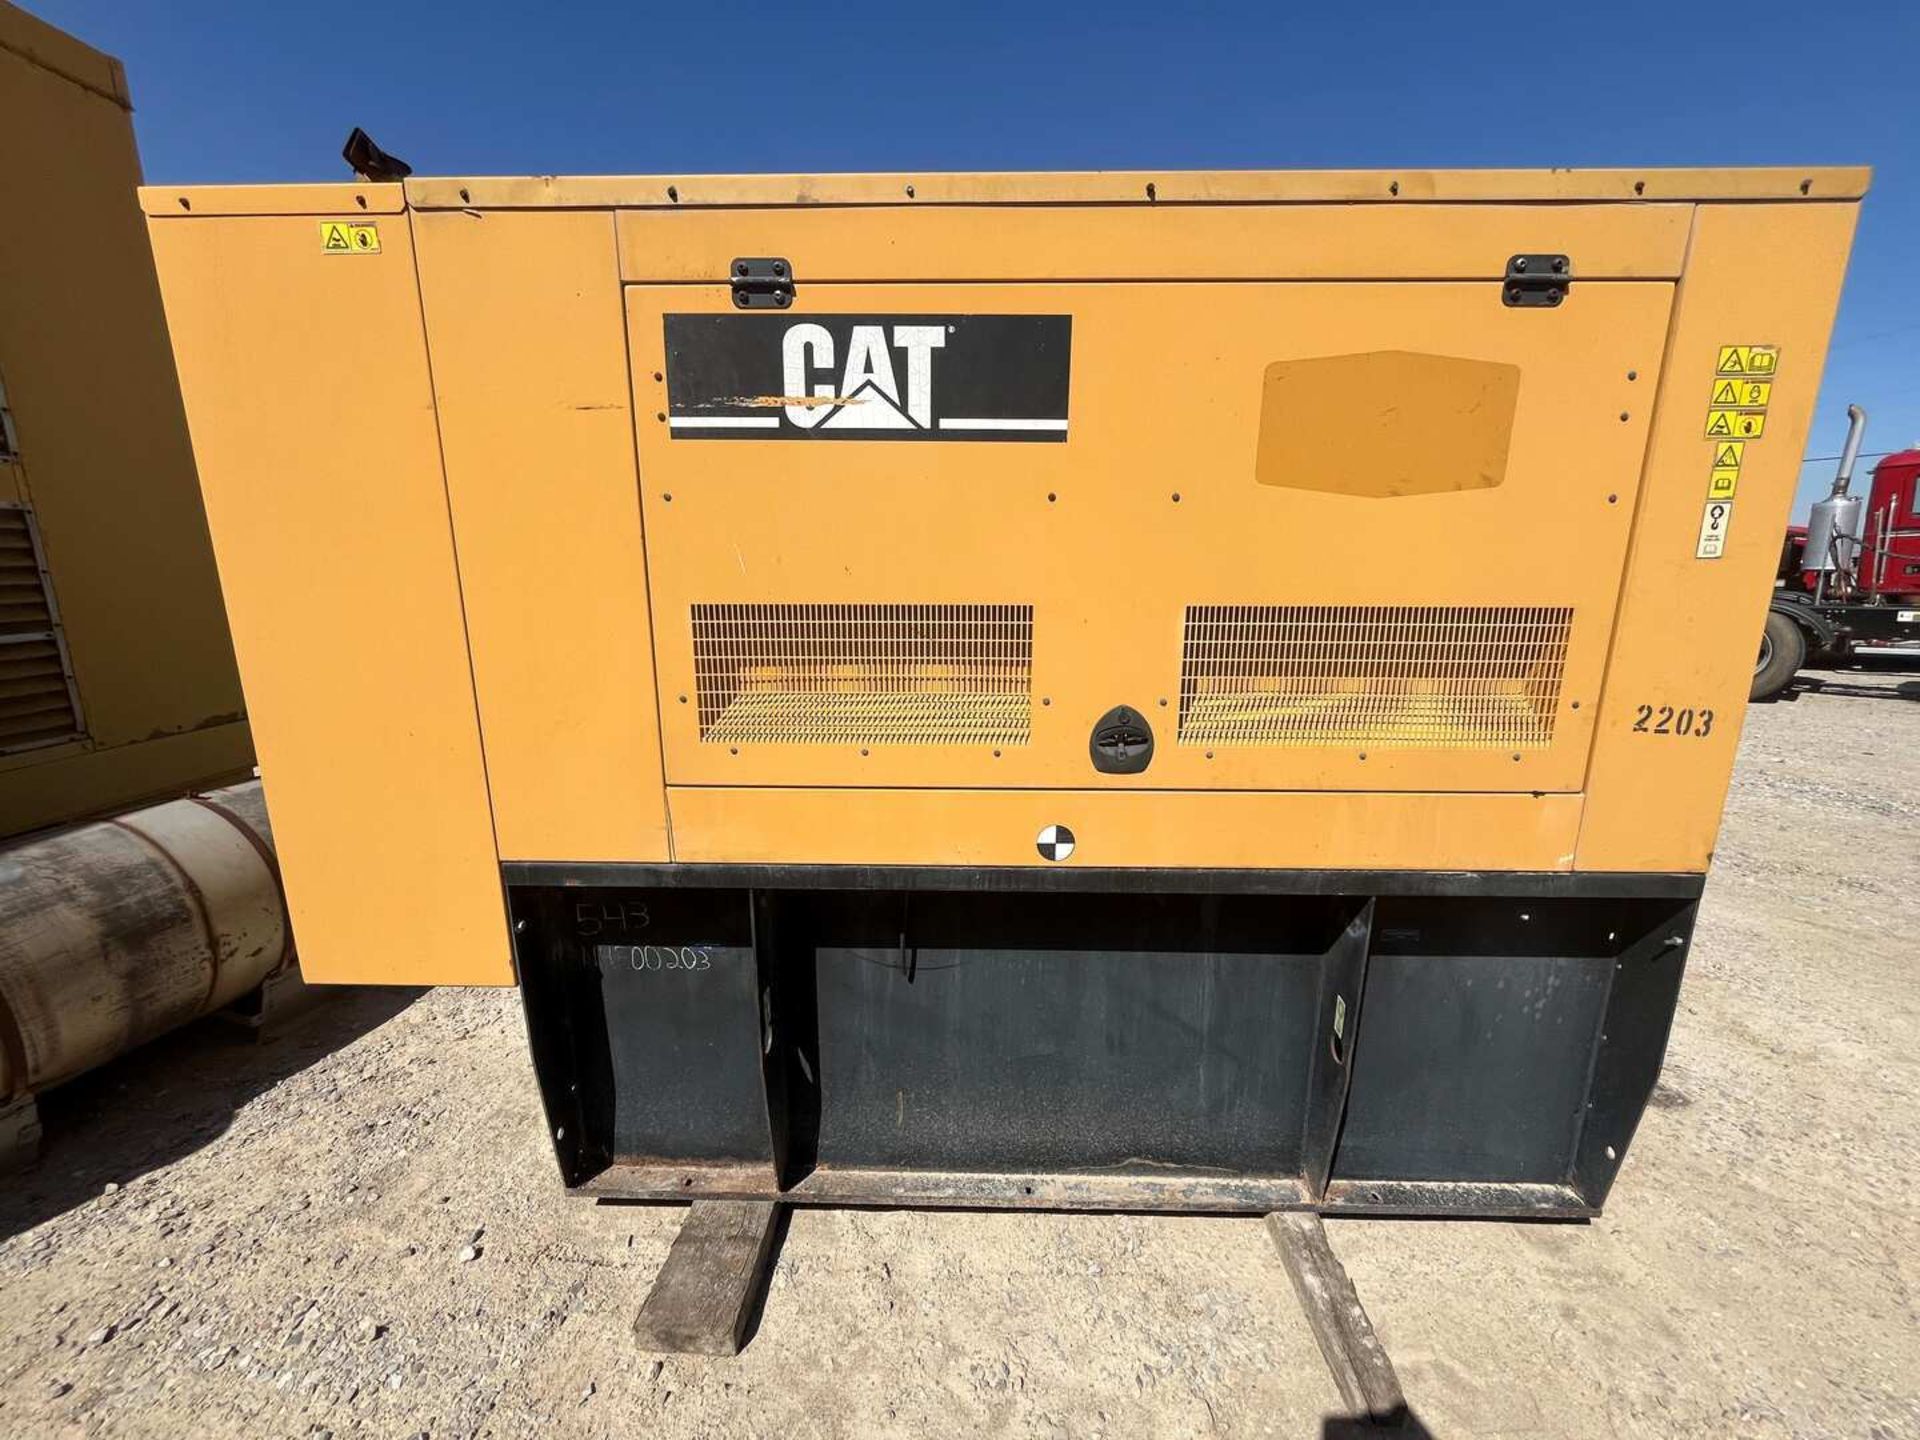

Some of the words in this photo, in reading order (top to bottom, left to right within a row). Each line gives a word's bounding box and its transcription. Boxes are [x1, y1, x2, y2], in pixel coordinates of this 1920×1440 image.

[783, 323, 946, 429] CAT
[1633, 704, 1714, 737] 2203
[576, 901, 651, 936] 543
